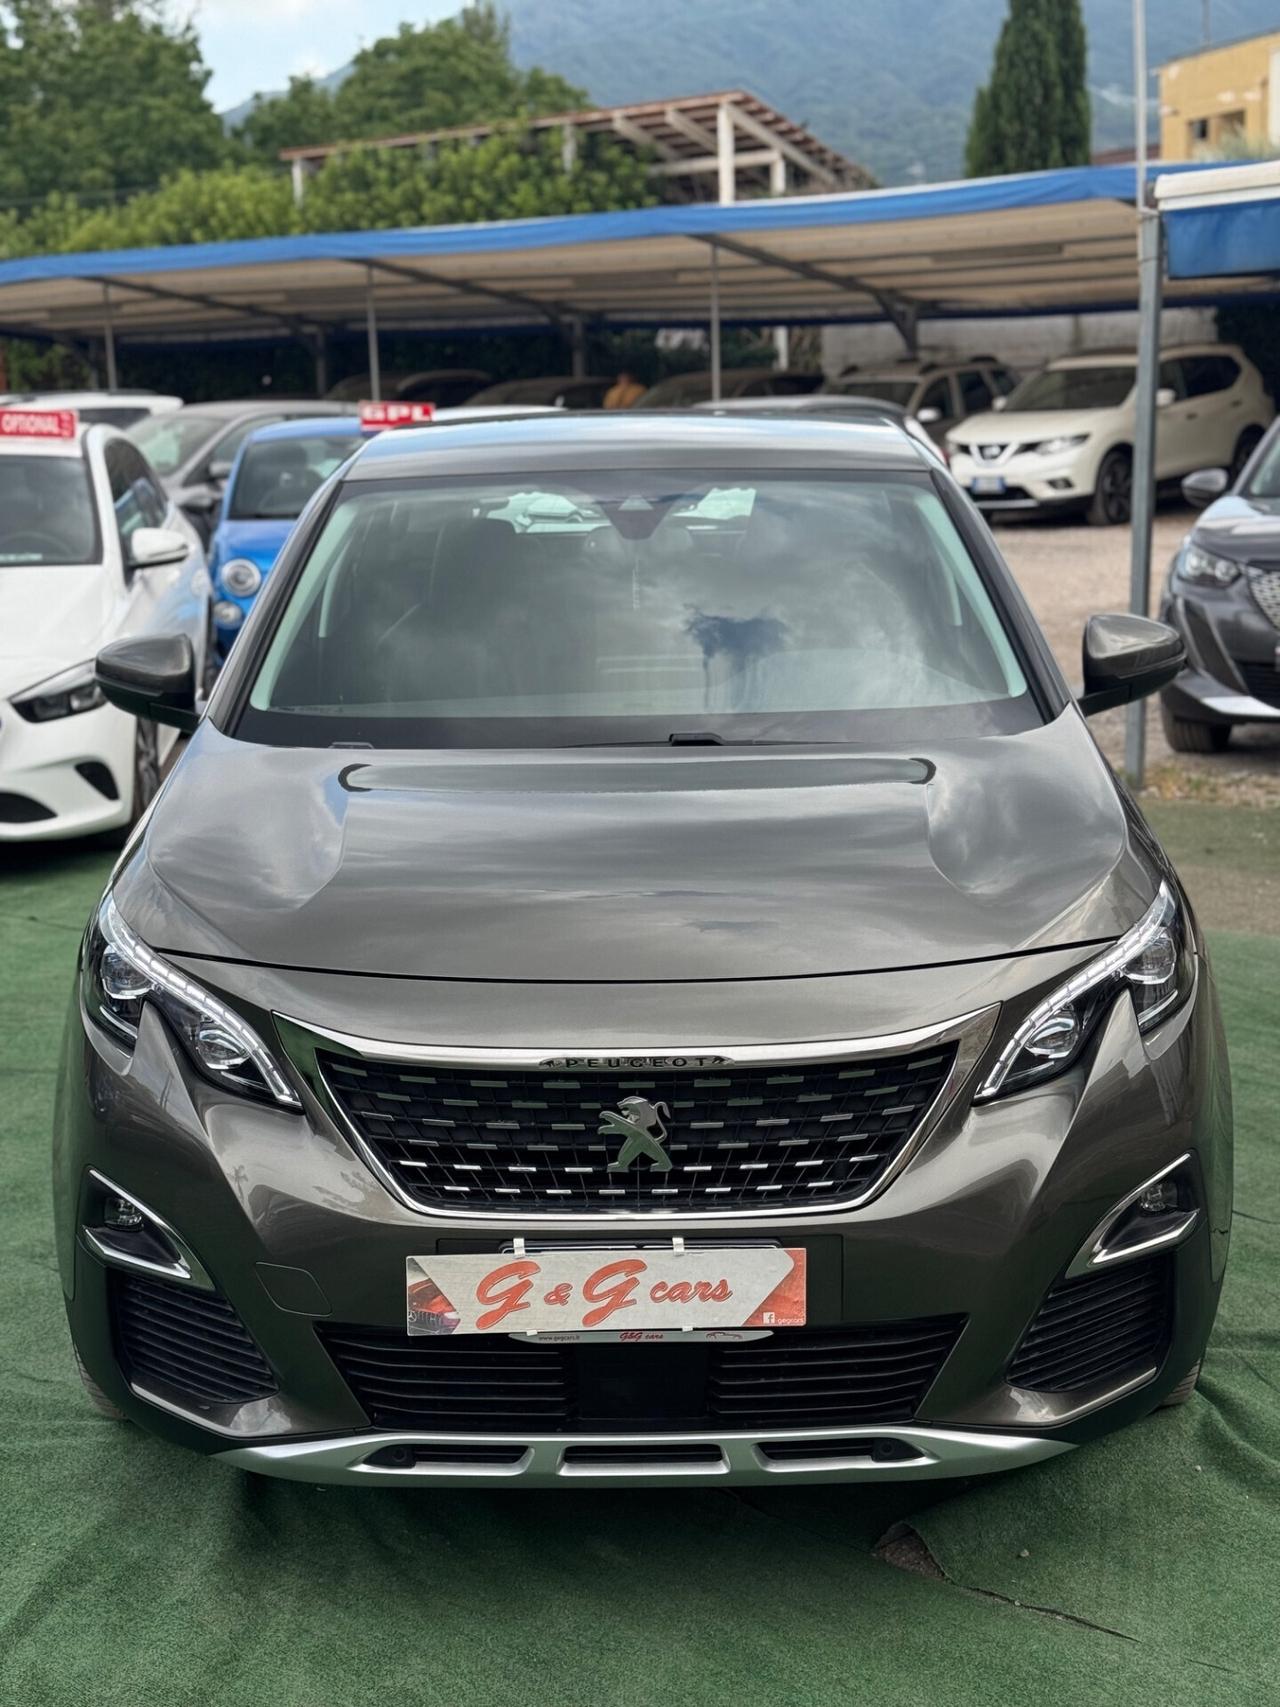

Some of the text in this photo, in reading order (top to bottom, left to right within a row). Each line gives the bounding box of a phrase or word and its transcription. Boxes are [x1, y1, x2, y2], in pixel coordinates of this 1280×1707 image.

[362, 404, 432, 421] GPL
[1, 413, 60, 434] OPTIONAL
[565, 1057, 707, 1068] PEUGEOT
[475, 1259, 733, 1330] G & G cars
[619, 1331, 643, 1342] G&G
